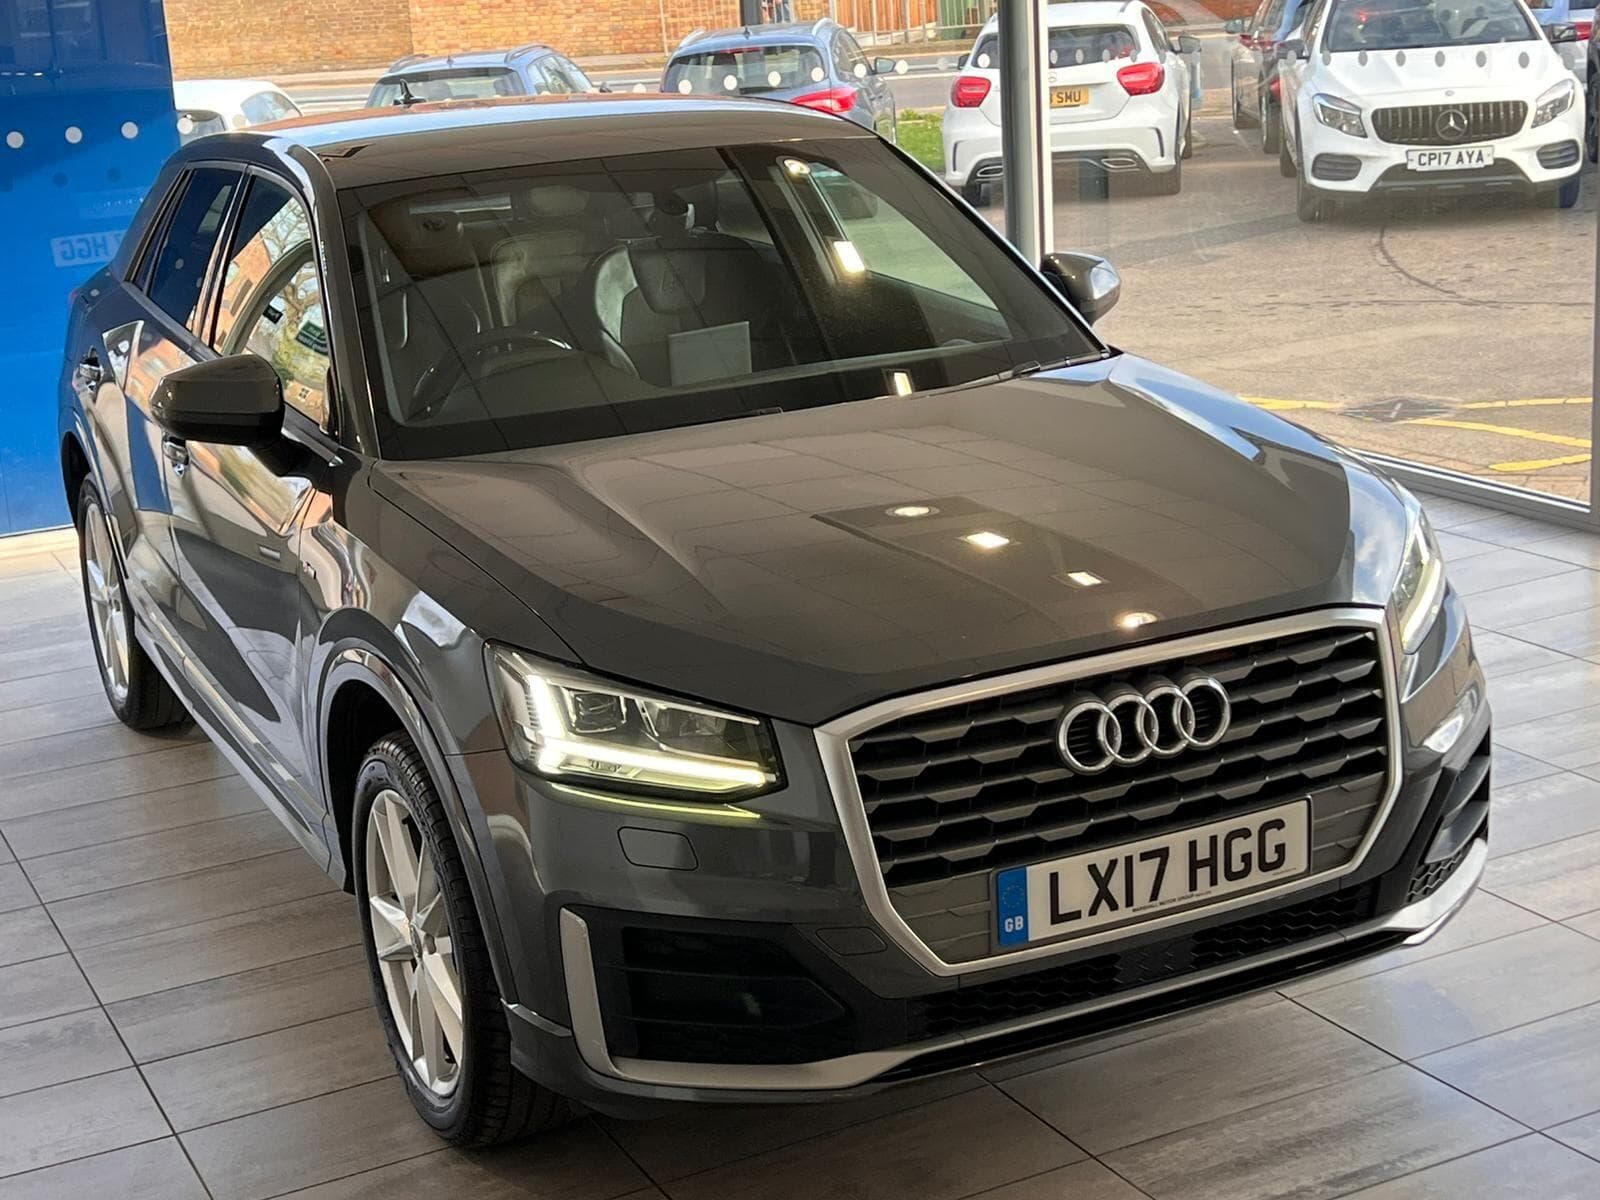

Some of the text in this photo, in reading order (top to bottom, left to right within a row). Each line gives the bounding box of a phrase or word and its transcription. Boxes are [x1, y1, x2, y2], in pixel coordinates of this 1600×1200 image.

[1418, 150, 1484, 166] CP17 AYA
[1050, 818, 1286, 925] LX17 HGG
[1004, 916, 1024, 933] GB
